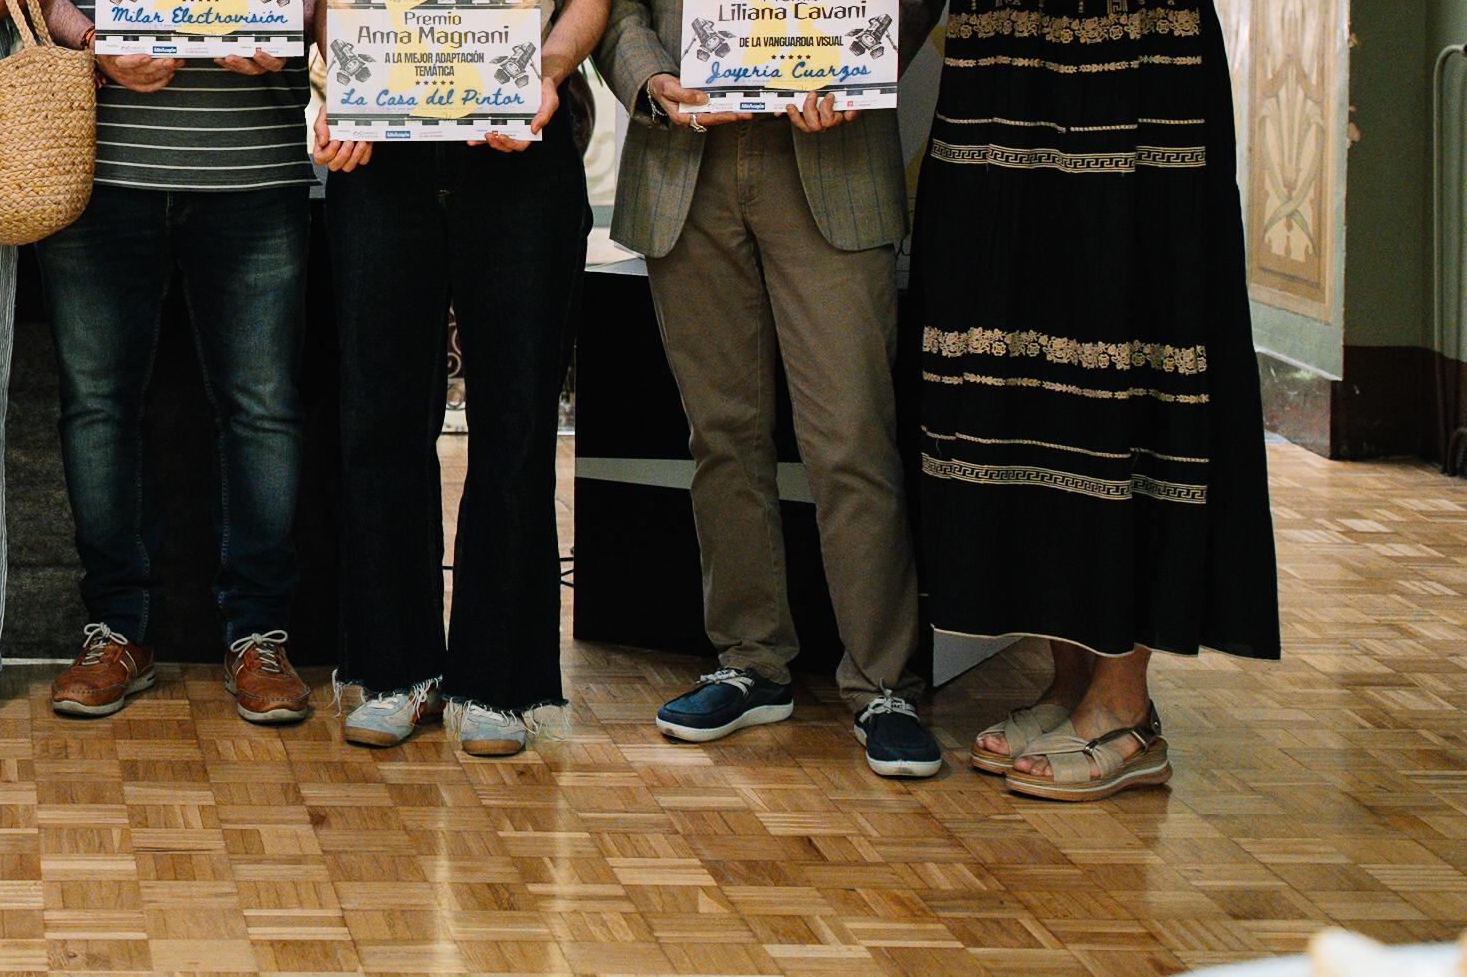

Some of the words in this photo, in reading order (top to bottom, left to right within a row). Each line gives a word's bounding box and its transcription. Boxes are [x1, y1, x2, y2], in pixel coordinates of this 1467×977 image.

[111, 7, 164, 23] Milar
[172, 6, 288, 23] Electrovisión
[404, 11, 462, 25] Premio
[718, 3, 787, 22] Liliana
[794, 0, 867, 20] Cavani
[357, 26, 412, 44] Anna
[419, 26, 509, 48] Magnani
[739, 37, 750, 48] DE
[751, 36, 762, 47] LA
[763, 35, 814, 47] VANGUARDIA
[816, 35, 844, 46] VISUAL
[385, 53, 391, 63] A
[393, 53, 402, 63] LA
[404, 53, 433, 63] MEJOR
[435, 51, 484, 63] ADAPTACIÓN
[415, 64, 454, 77] TEMÁTICA
[705, 61, 783, 84] Joyería
[792, 61, 872, 82] Cuarzos
[340, 88, 368, 106] La
[376, 89, 418, 106] Casa
[426, 88, 454, 106] del
[461, 88, 525, 106] Pintor
